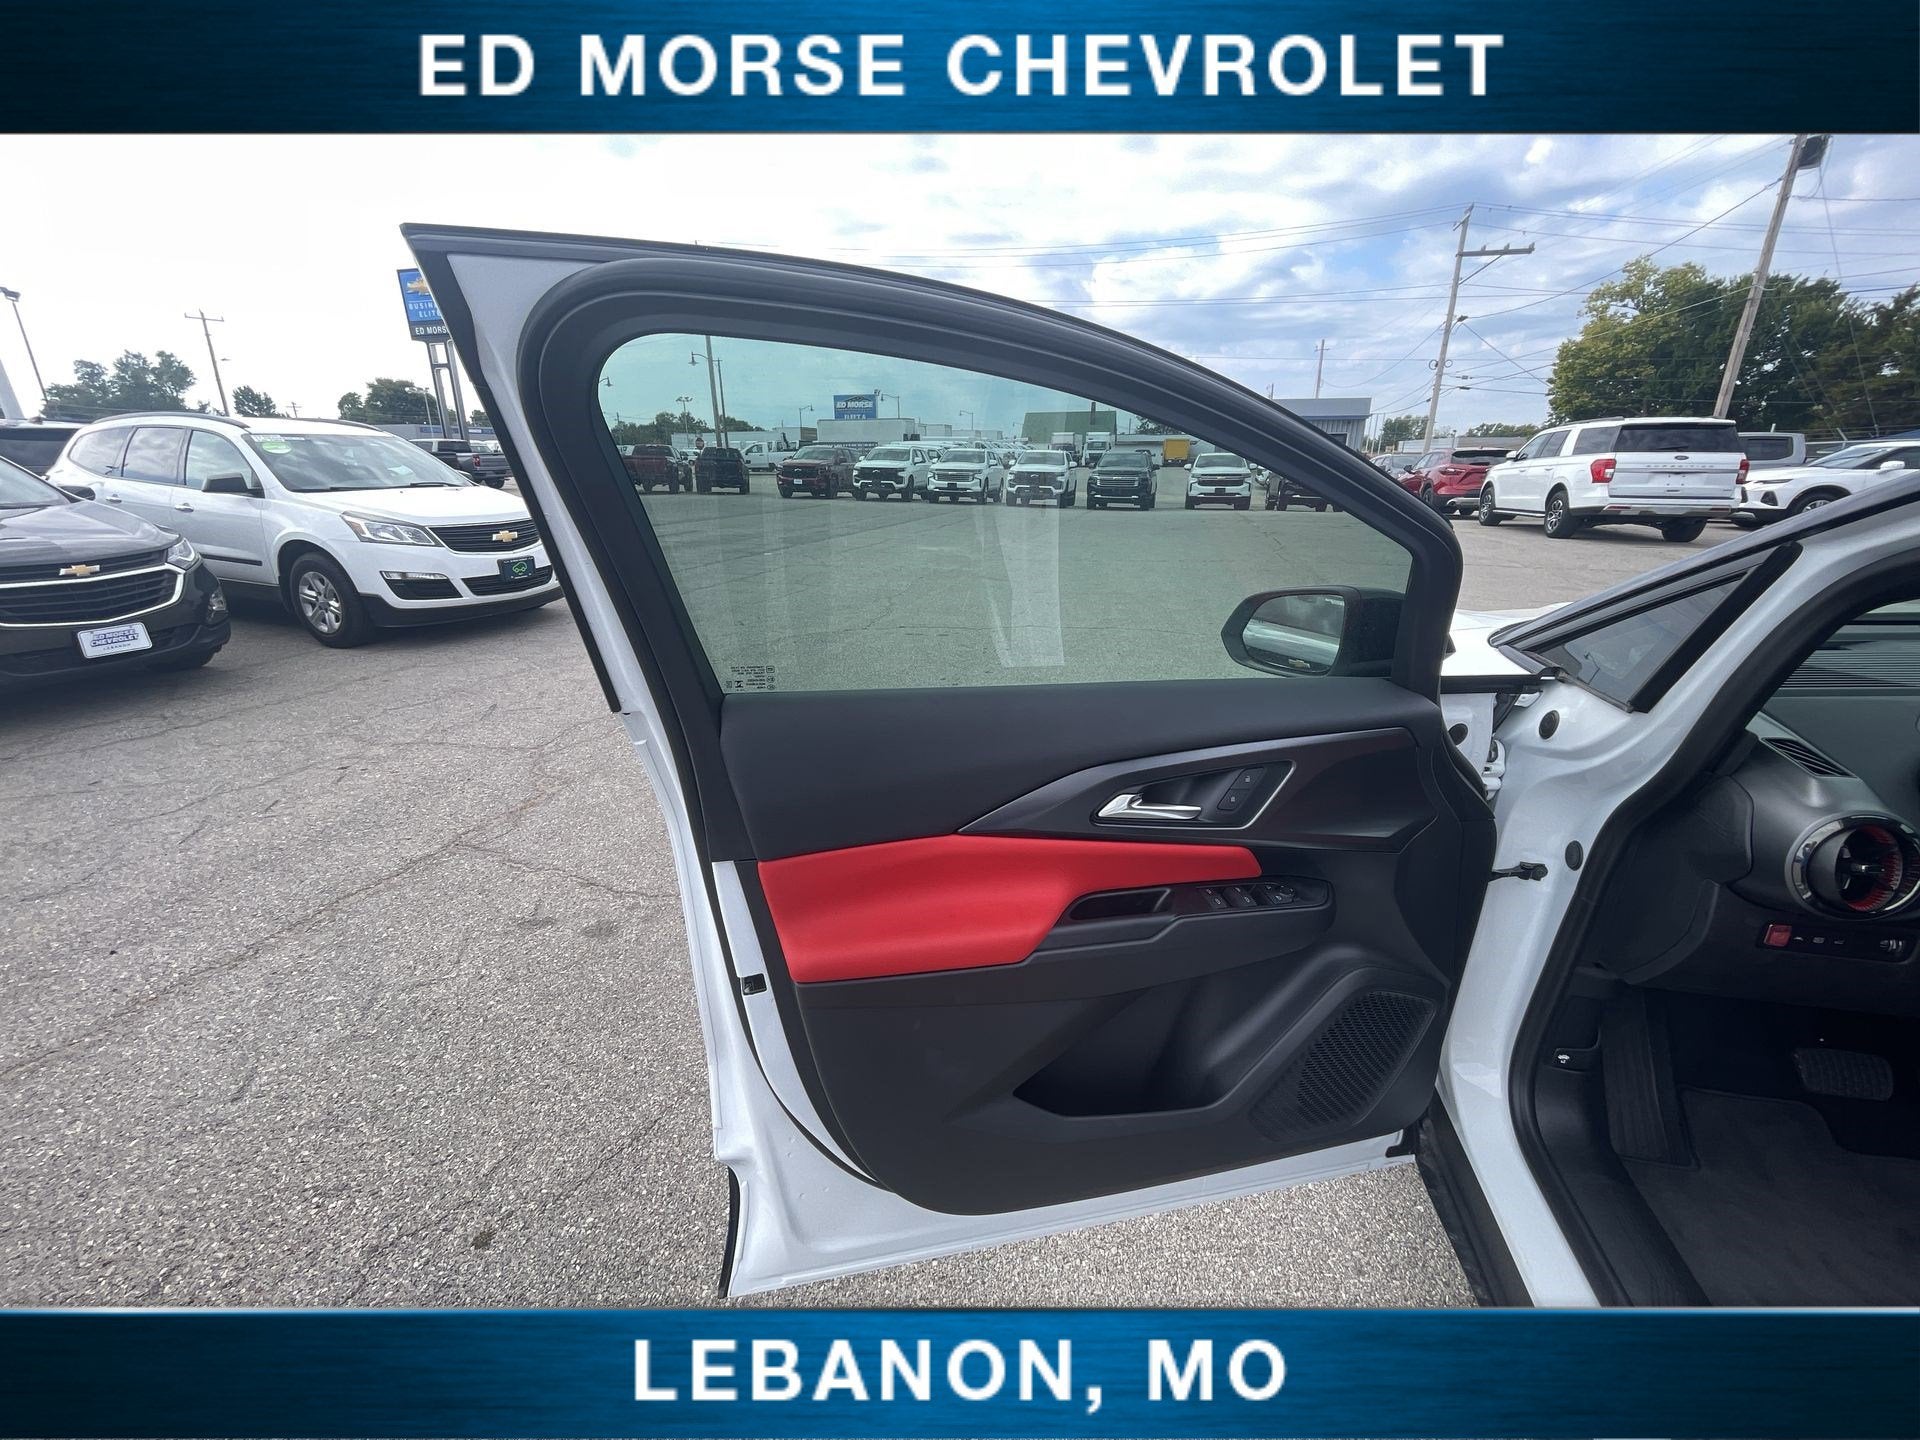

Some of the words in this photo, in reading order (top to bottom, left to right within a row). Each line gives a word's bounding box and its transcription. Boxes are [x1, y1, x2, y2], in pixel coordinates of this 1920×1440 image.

[408, 302, 437, 310] BUSIN
[415, 327, 425, 335] ED
[426, 325, 448, 334] MORS
[105, 629, 136, 640] MORSE
